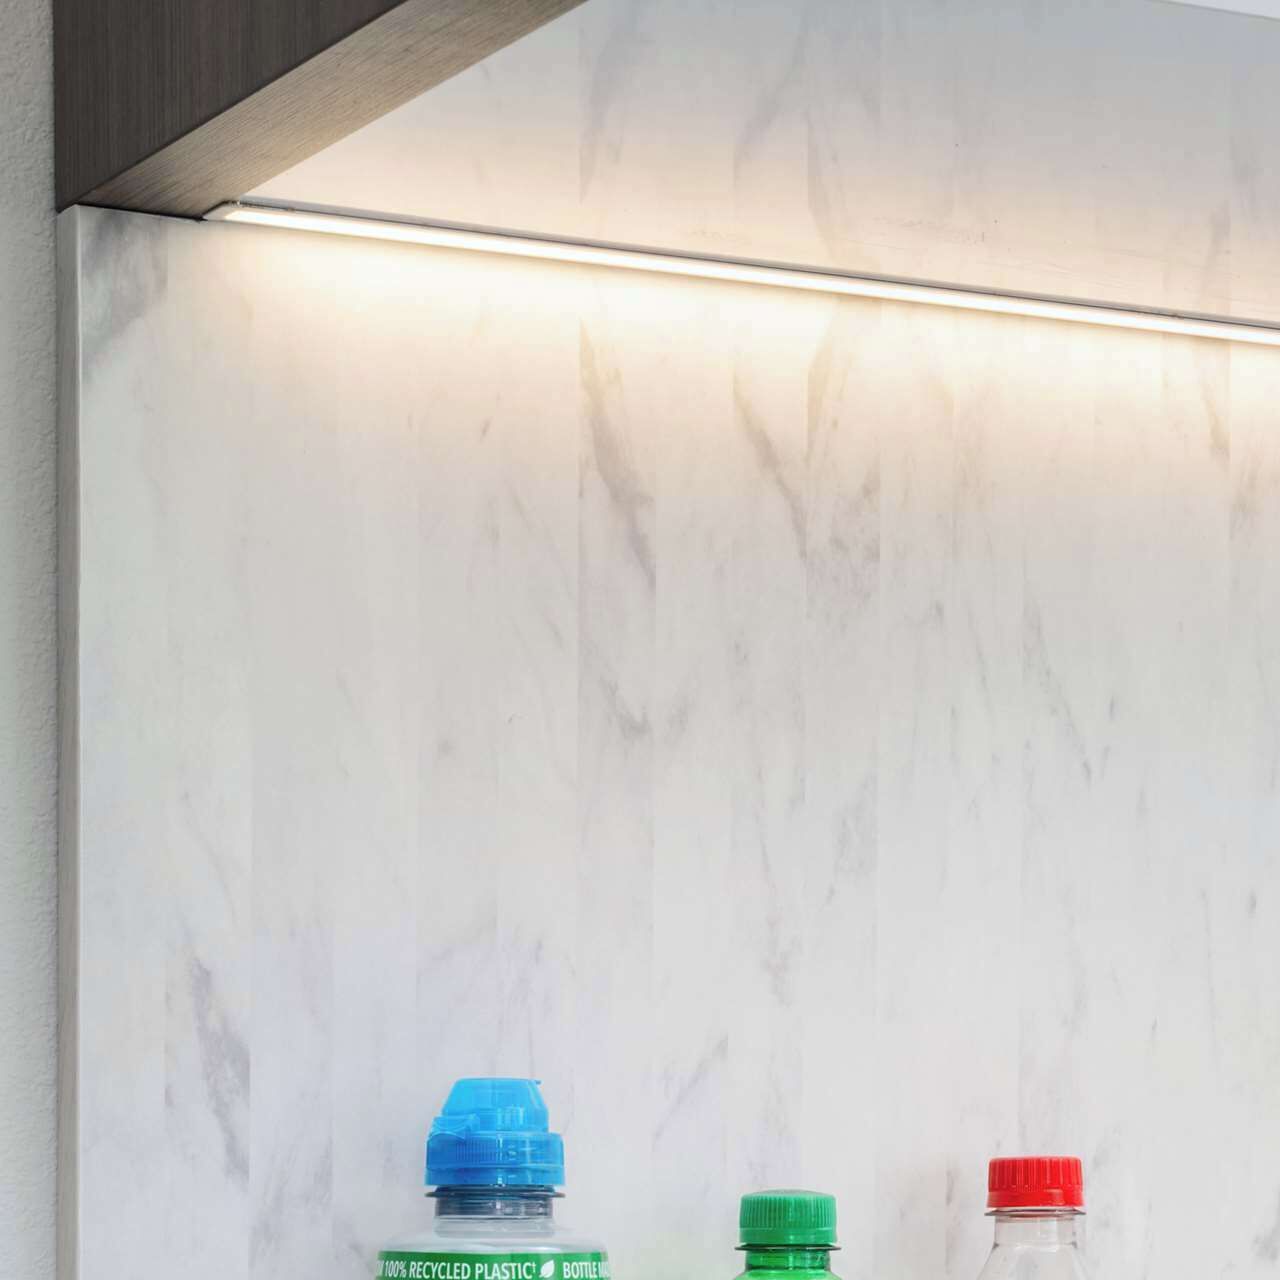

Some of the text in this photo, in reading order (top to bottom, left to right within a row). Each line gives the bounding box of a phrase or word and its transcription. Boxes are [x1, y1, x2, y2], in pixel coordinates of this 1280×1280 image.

[385, 1261, 407, 1279] 100%
[409, 1261, 471, 1280] RECYCLED
[563, 1261, 598, 1279] BOTTLE
